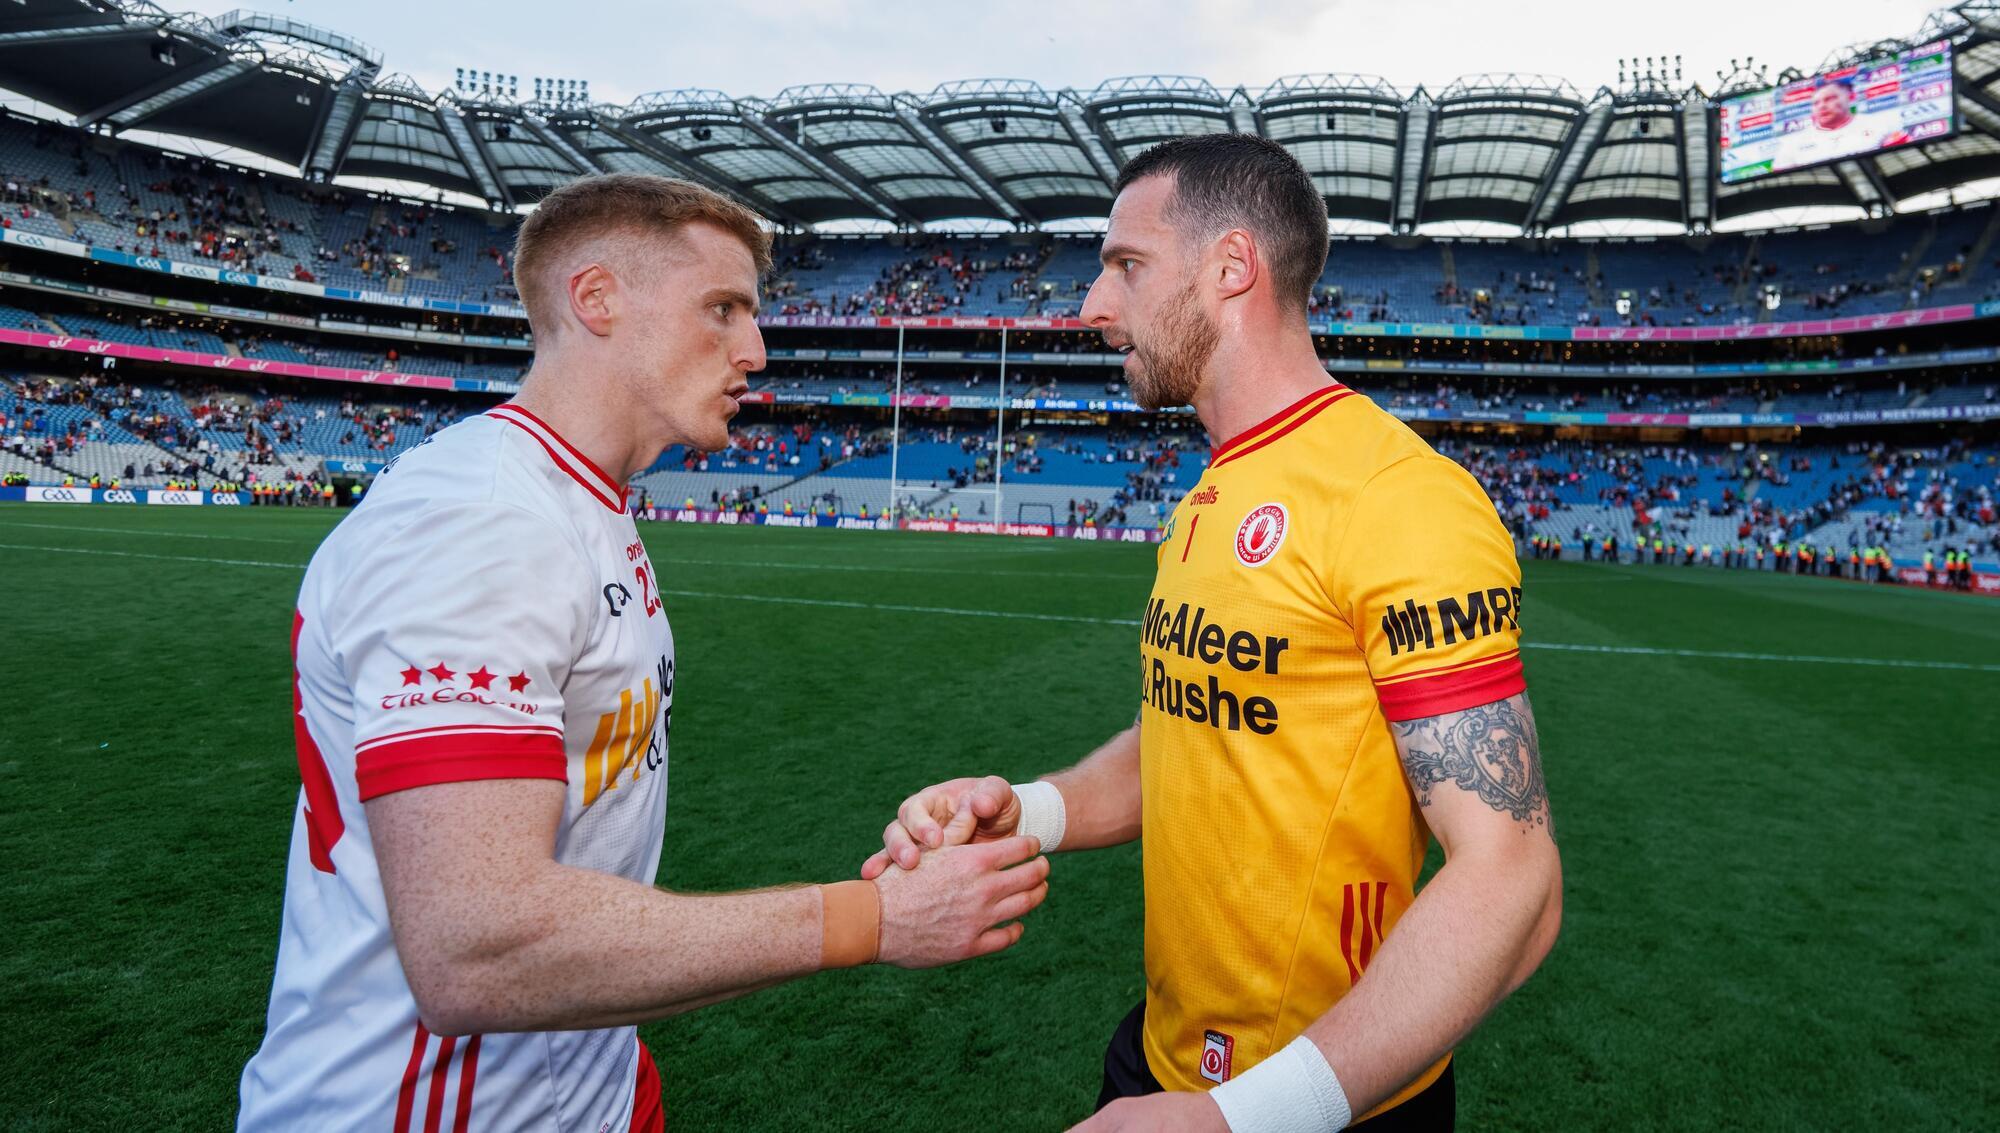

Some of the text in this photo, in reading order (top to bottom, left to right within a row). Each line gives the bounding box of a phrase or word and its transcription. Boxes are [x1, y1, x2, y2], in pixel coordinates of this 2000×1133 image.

[358, 291, 405, 307] Allianz
[42, 487, 76, 502] GAA
[103, 489, 137, 504] GAA
[212, 492, 240, 505] GAA
[637, 507, 656, 521] AB
[676, 509, 697, 523] AIB
[716, 511, 738, 525] AIB
[764, 514, 801, 527] Allianz
[836, 516, 875, 530] Allianz
[1073, 526, 1097, 540] AIB
[1121, 527, 1146, 542] AIB
[1182, 513, 1200, 562] 1
[1140, 597, 1289, 675] McAleer
[1151, 657, 1279, 735] Rushe
